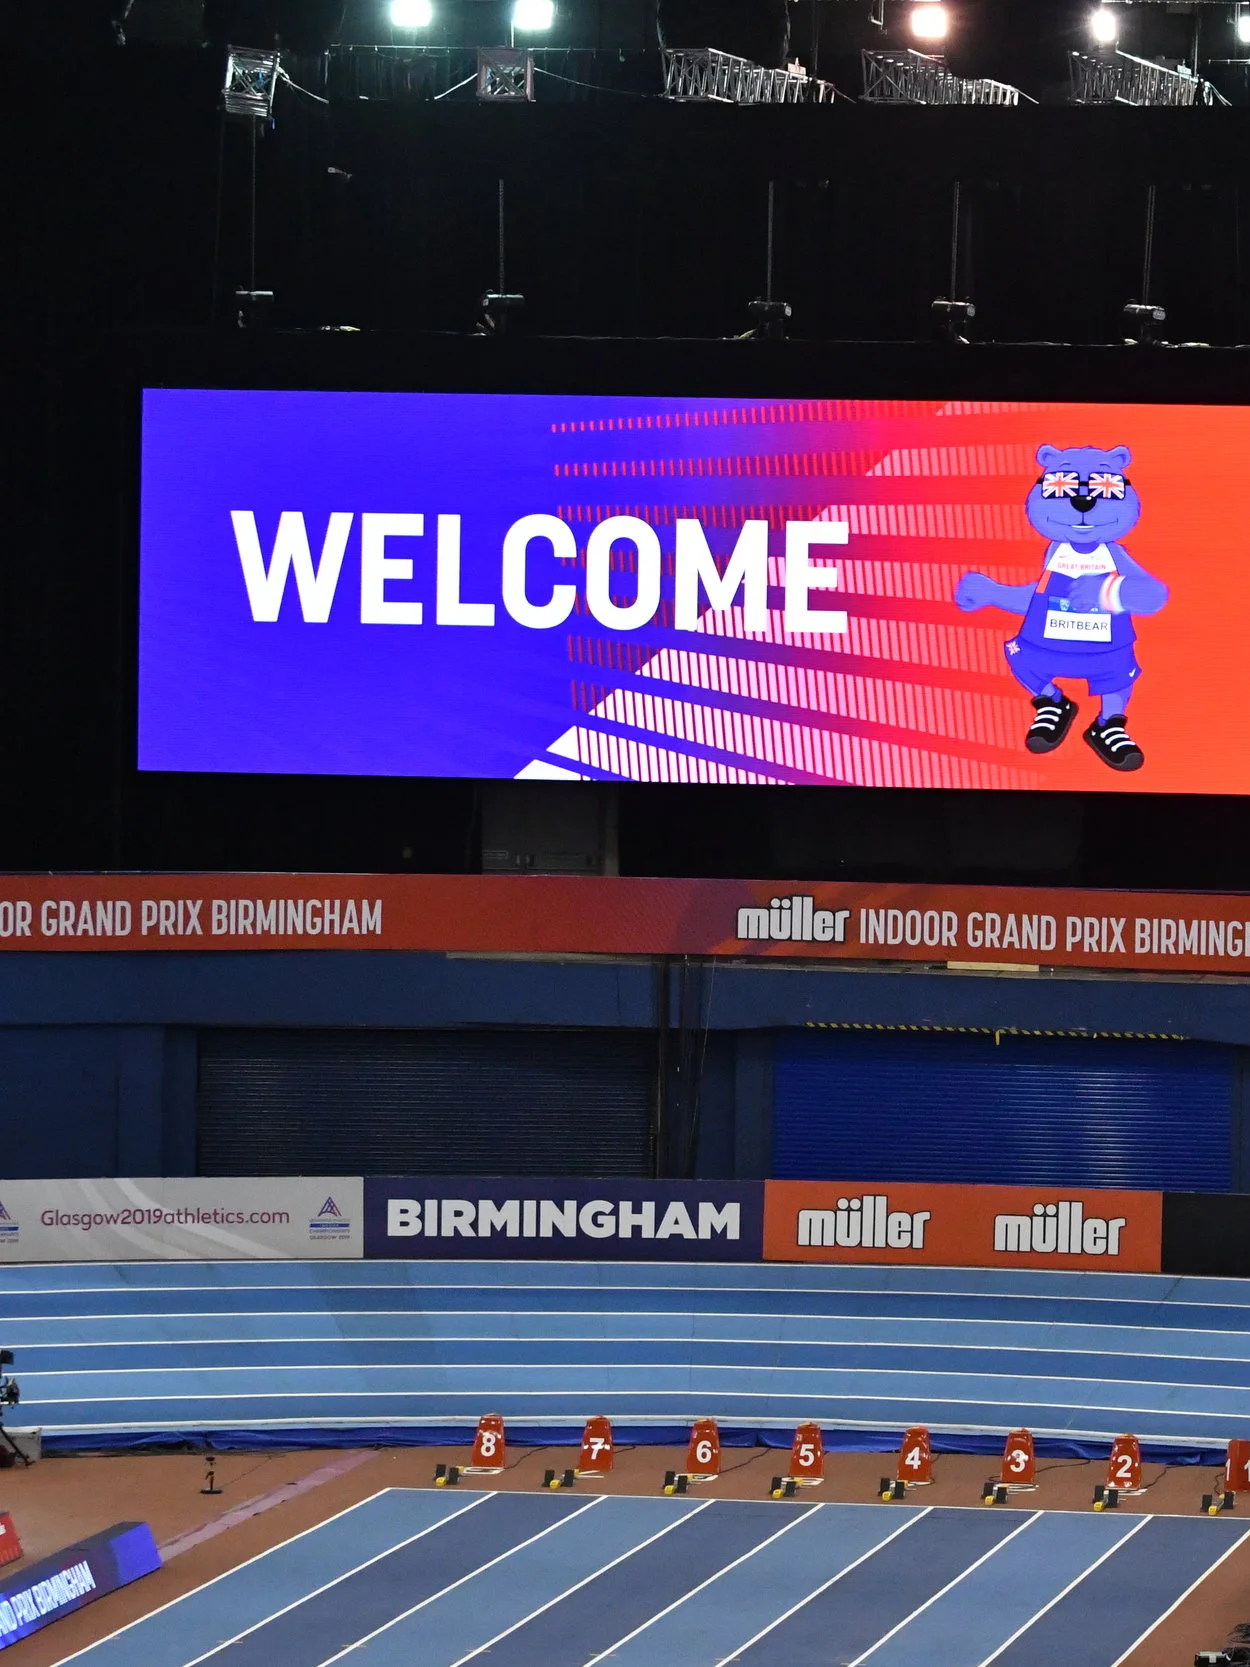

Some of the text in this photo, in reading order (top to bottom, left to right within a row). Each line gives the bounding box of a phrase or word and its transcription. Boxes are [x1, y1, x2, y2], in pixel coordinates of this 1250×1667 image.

[229, 509, 850, 634] WELCOME
[1050, 619, 1108, 631] BRITBEAR
[41, 900, 132, 936] GRAND
[141, 900, 204, 937] PRIX
[211, 899, 383, 936] BIRMINGHAM
[737, 895, 852, 943] müller
[859, 907, 958, 948] INDOOR
[966, 911, 1057, 951] GRAND
[1065, 915, 1125, 954] PRIX
[40, 1207, 290, 1231] Glasgow2019athletics.com
[386, 1199, 741, 1240] BIRMINGHAM
[797, 1194, 931, 1249] müller
[993, 1200, 1127, 1257] müller
[480, 1432, 496, 1458] 8
[589, 1436, 605, 1460] 7
[695, 1439, 712, 1464] 6
[798, 1443, 815, 1467] 5
[904, 1446, 922, 1470] 4
[1009, 1449, 1027, 1473] 3
[1115, 1454, 1133, 1478] 2
[10, 1588, 41, 1627] PRIX
[31, 1559, 97, 1616] BIRMINGHAM
